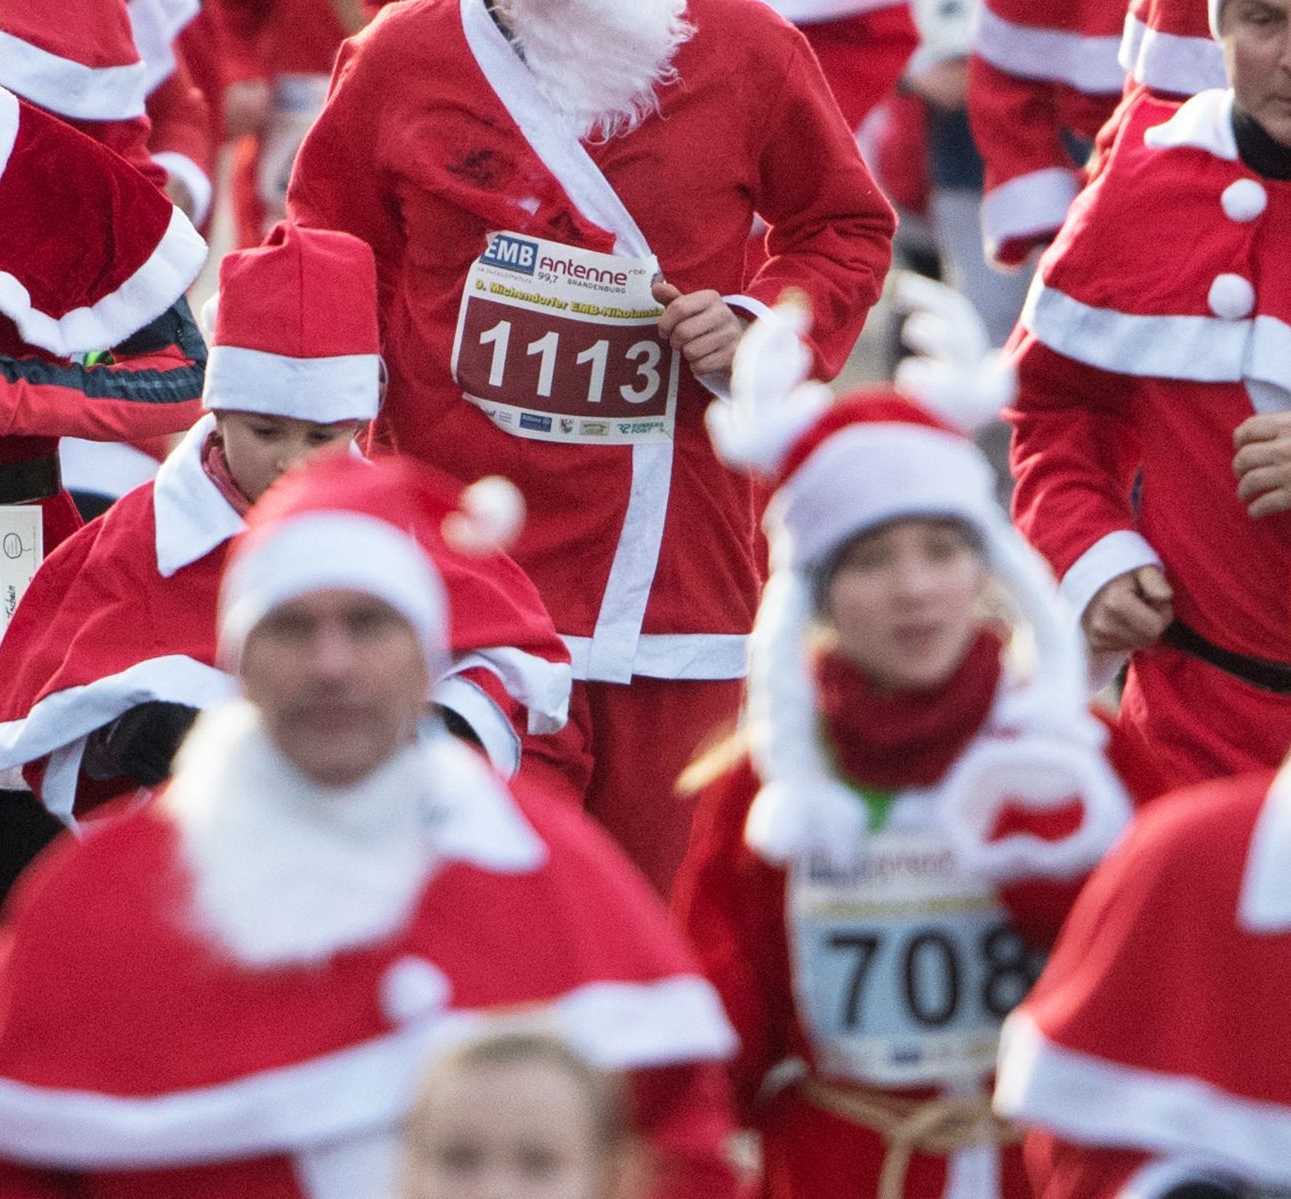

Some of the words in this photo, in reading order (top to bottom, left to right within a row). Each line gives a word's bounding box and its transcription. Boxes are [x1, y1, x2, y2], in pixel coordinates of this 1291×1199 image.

[484, 238, 534, 268] EMB
[537, 271, 559, 284] 99,7
[539, 256, 628, 287] Antenne
[567, 278, 627, 295] BRANDENBURG
[479, 319, 662, 404] 1113
[823, 923, 1034, 1030] 708
